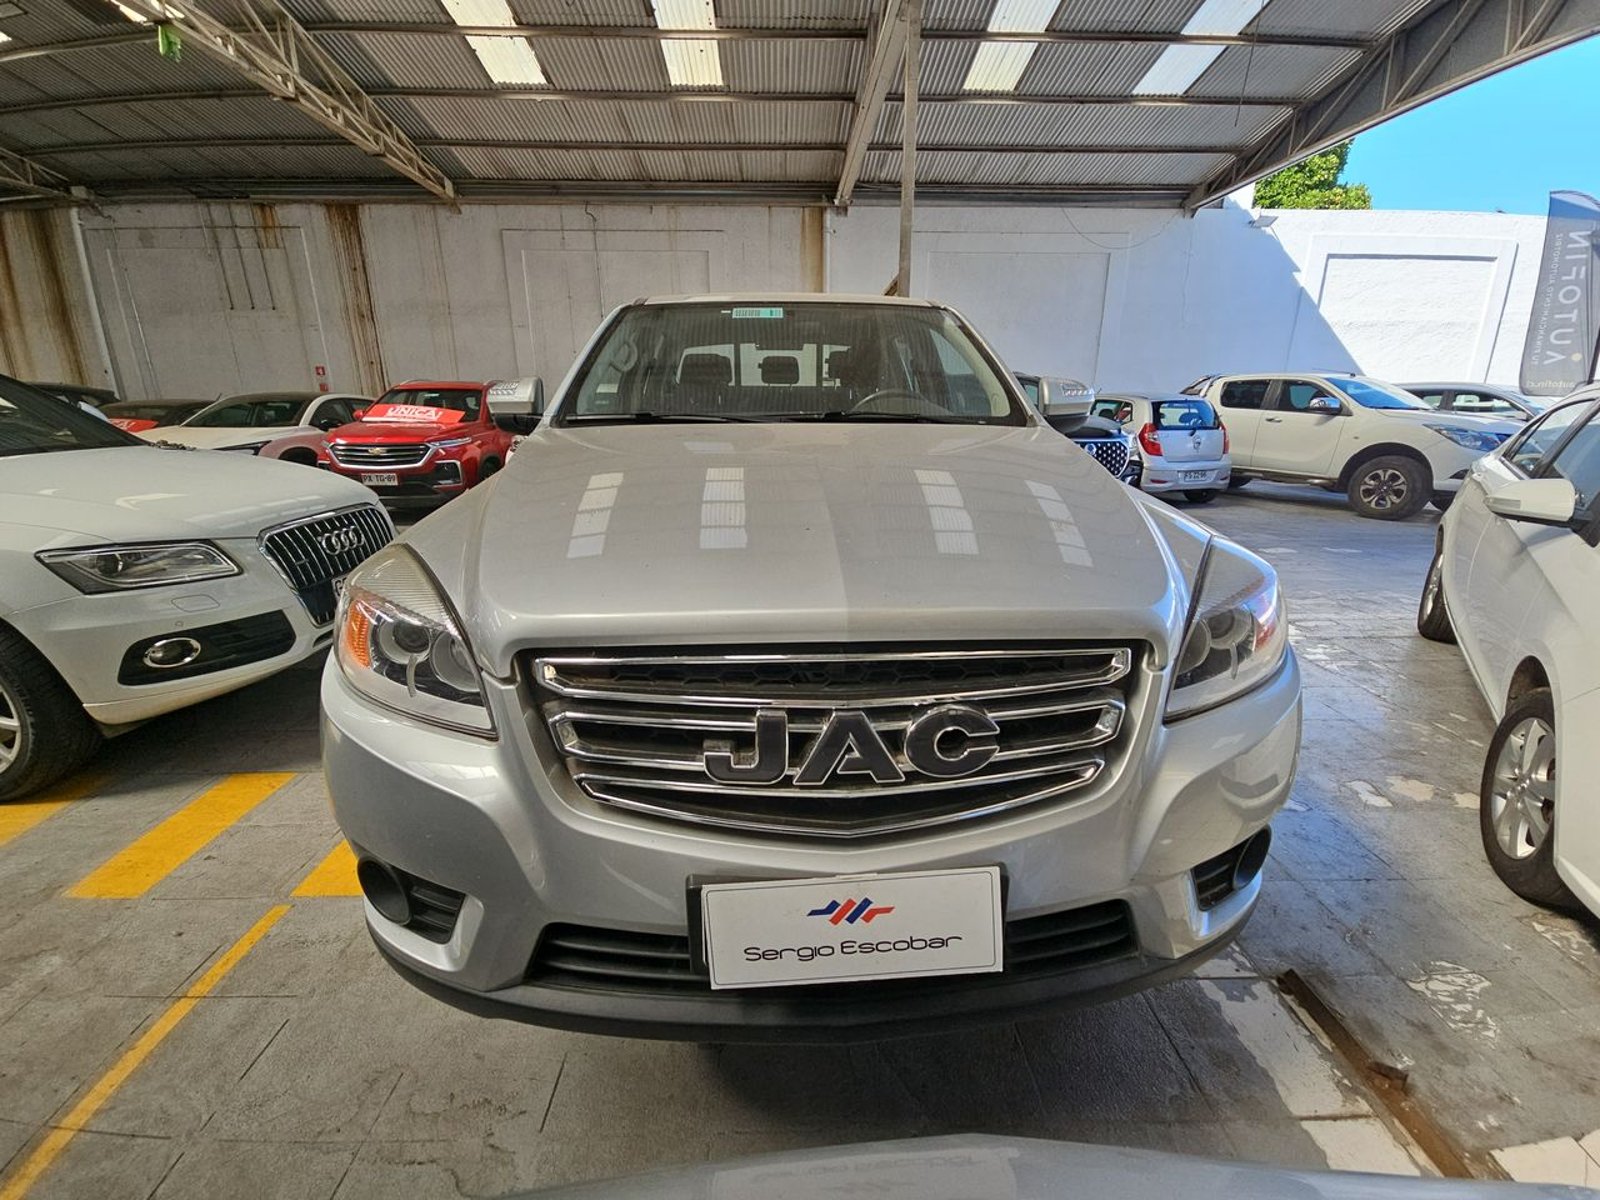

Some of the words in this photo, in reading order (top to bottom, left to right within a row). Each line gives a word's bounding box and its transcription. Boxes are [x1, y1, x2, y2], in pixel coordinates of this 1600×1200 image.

[703, 704, 1000, 786] JAC
[743, 946, 835, 962] Sergio
[840, 935, 963, 955] Escobar
